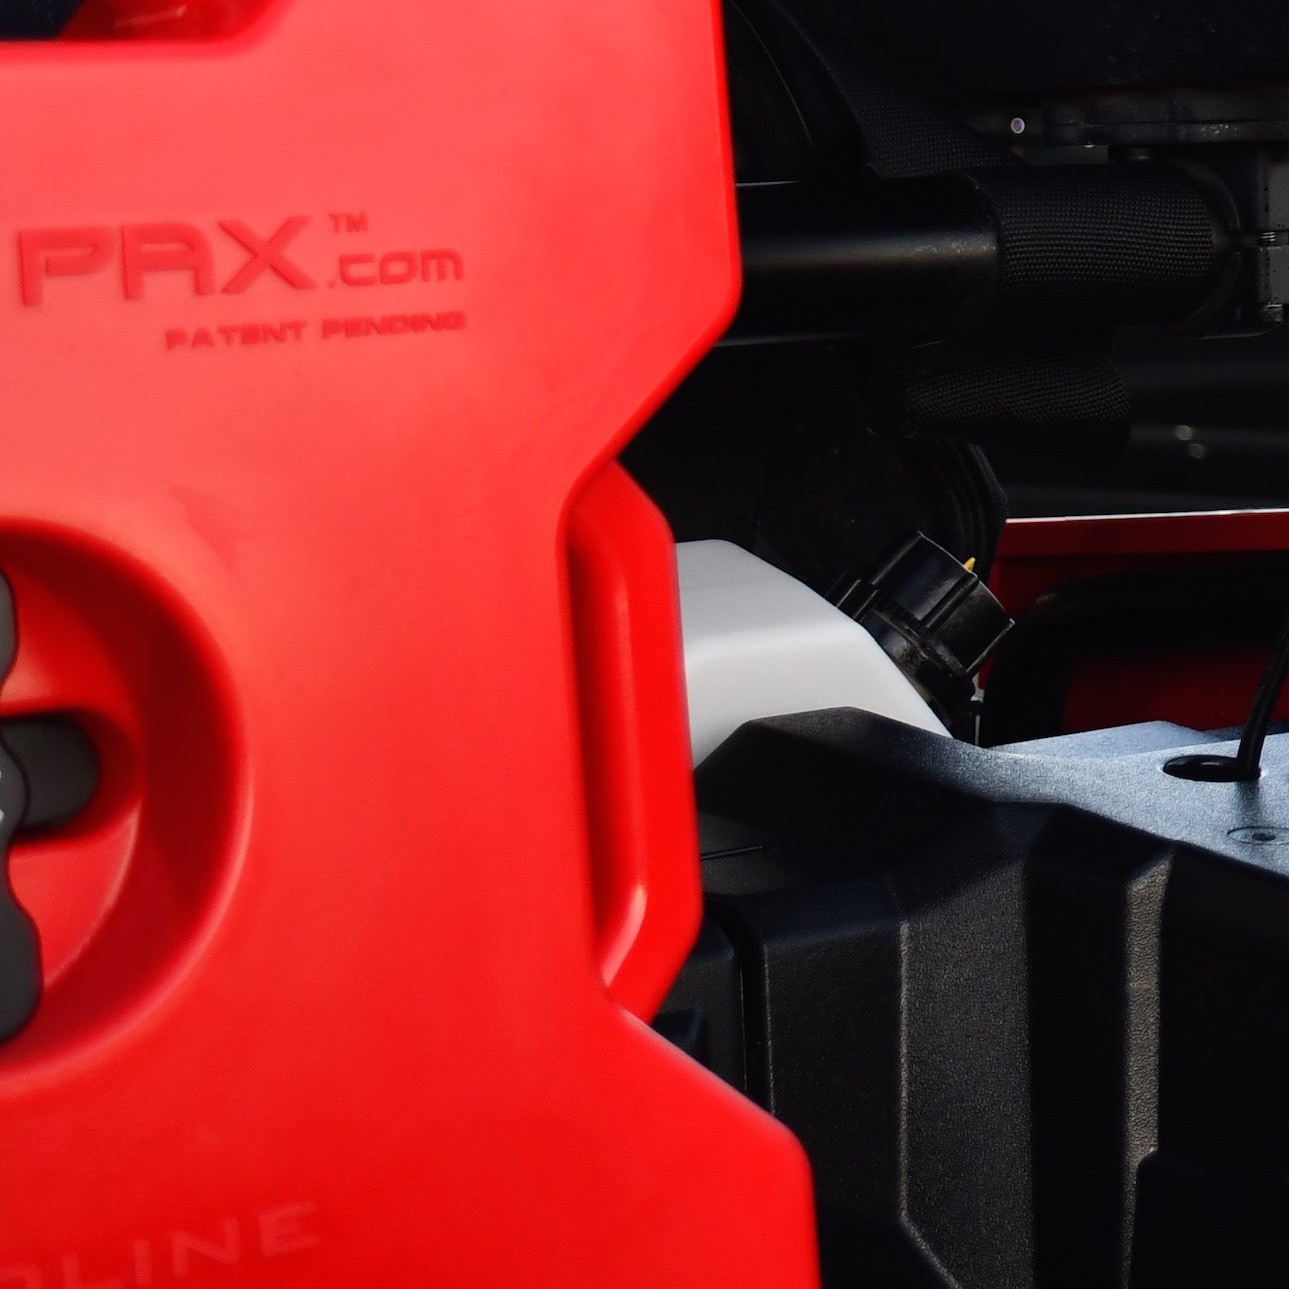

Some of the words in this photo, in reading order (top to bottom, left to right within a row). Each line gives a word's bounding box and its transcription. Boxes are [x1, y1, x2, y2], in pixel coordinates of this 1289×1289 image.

[17, 215, 316, 307] PAX
[165, 320, 308, 350] PATENT
[321, 311, 466, 340] PENDING
